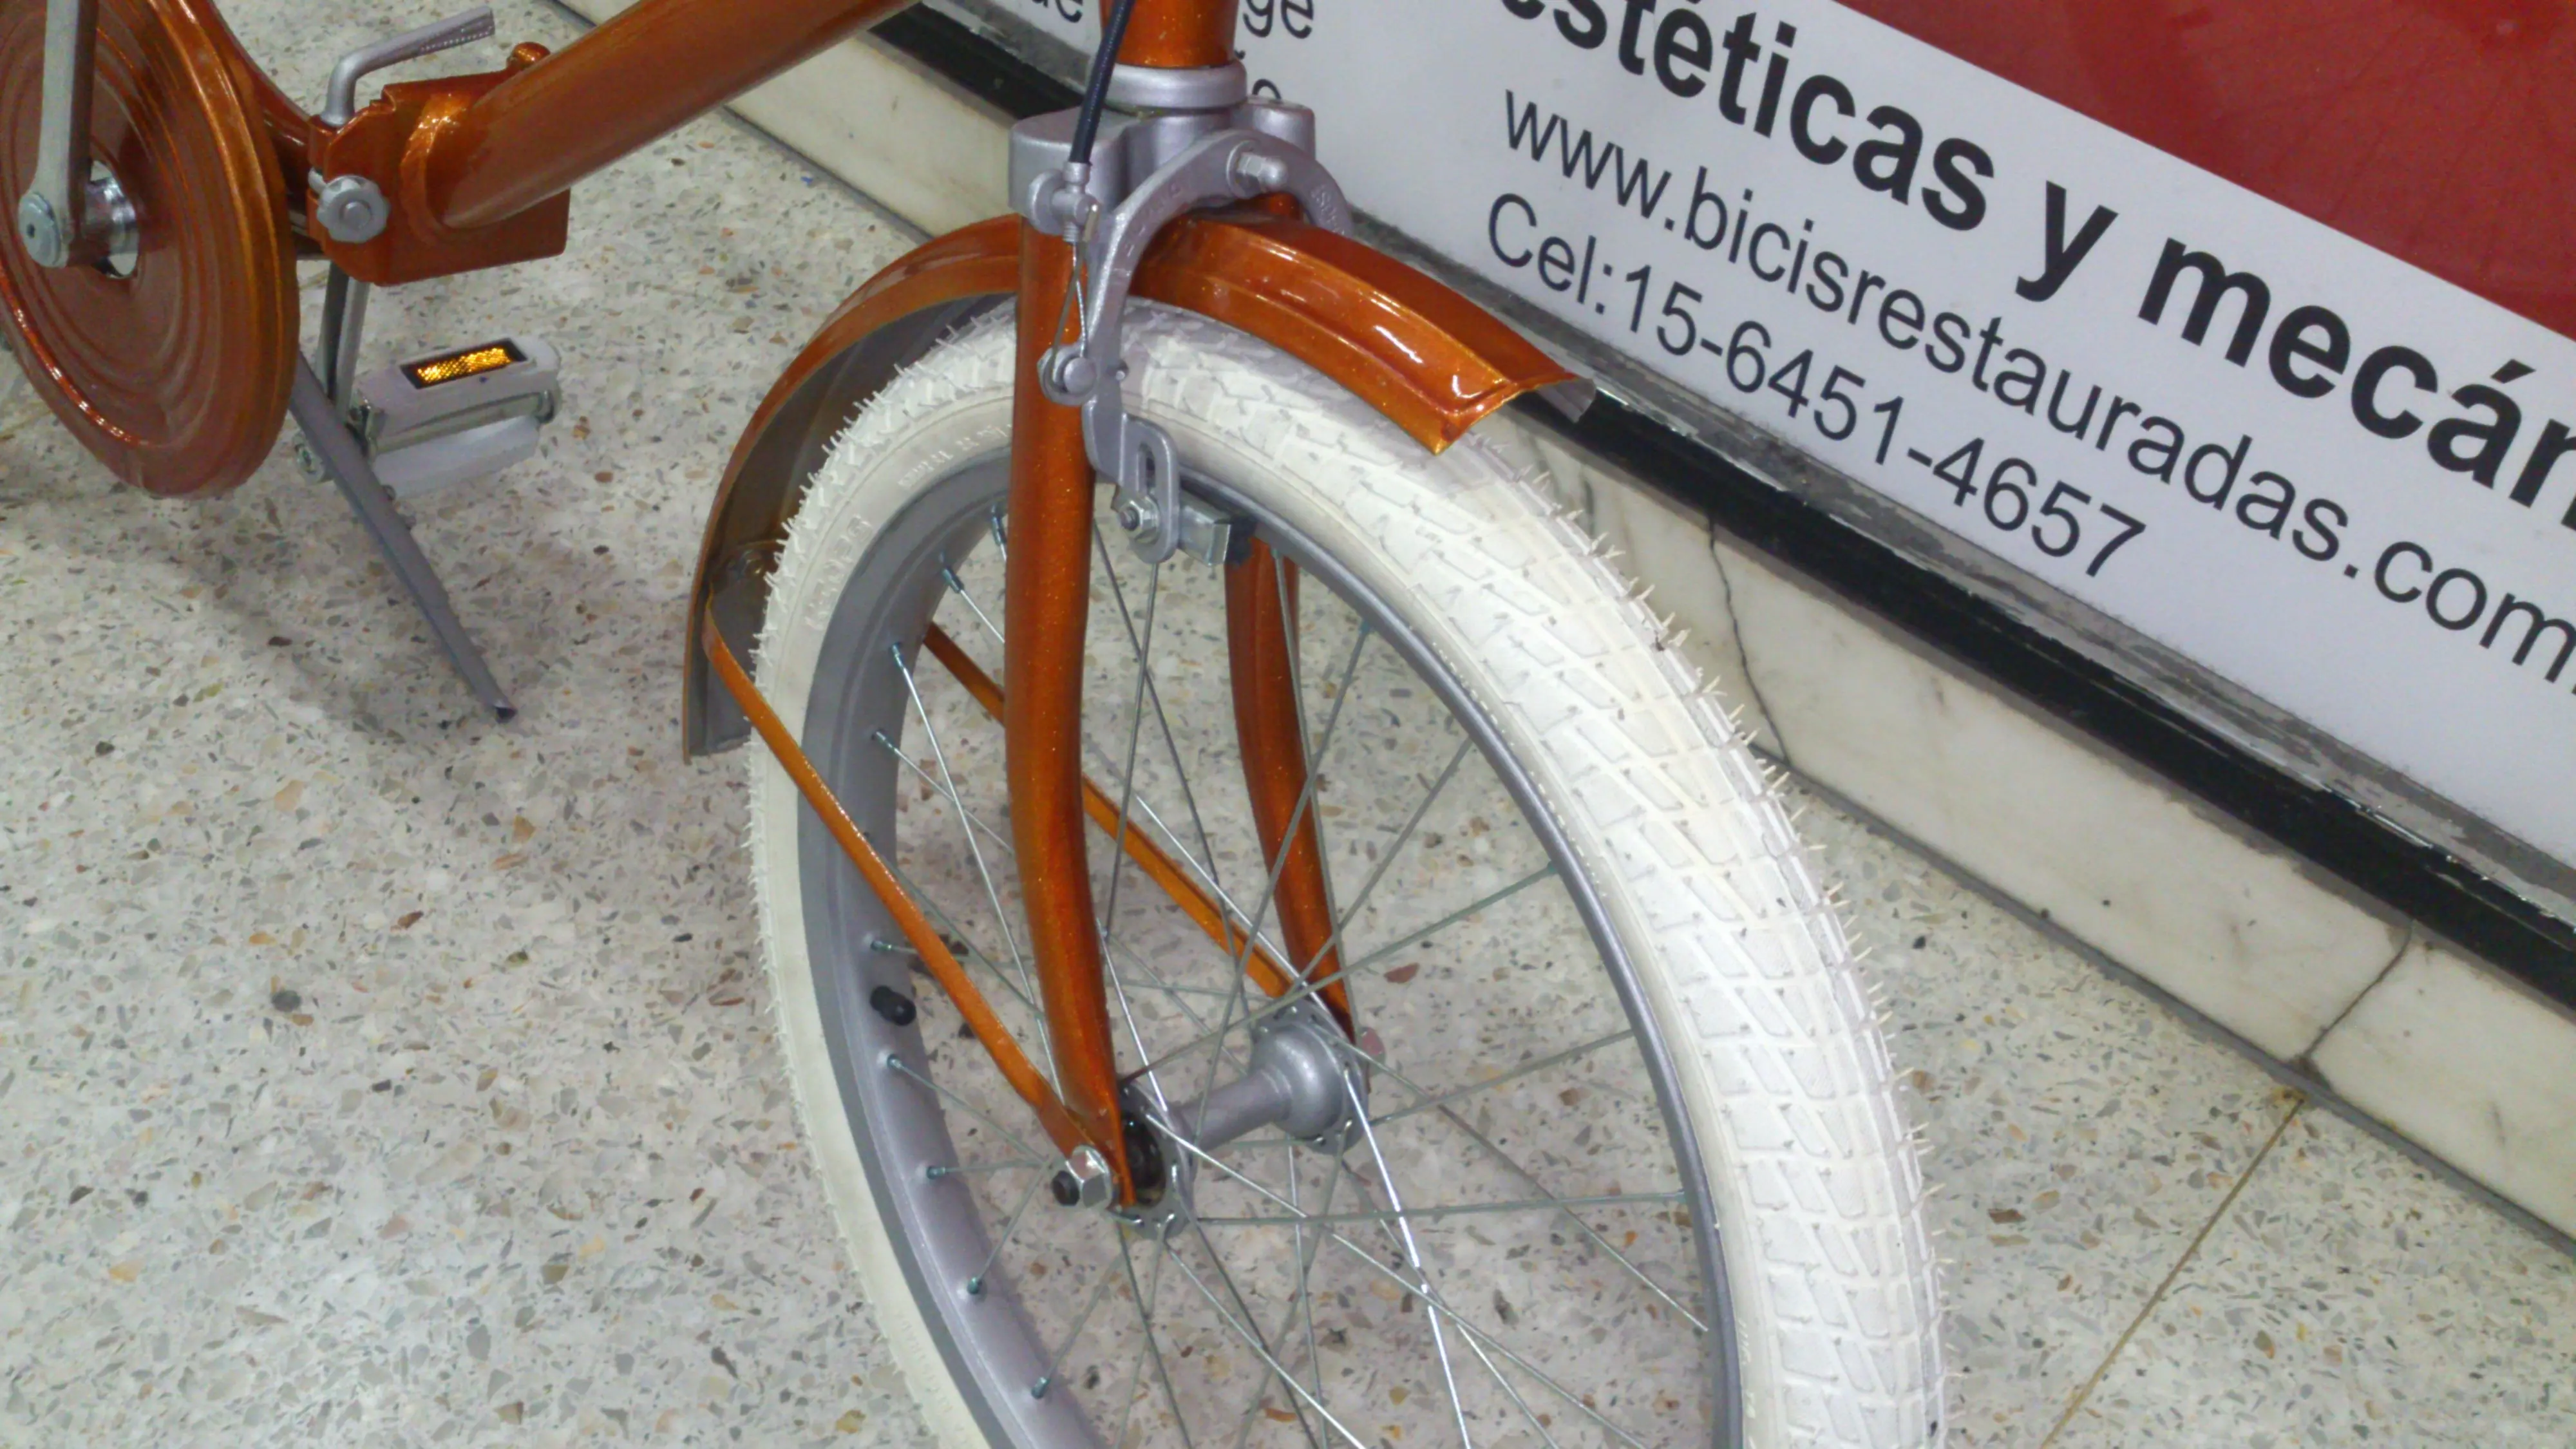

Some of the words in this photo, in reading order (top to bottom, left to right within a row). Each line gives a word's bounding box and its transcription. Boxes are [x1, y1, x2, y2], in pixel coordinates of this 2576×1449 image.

[1502, 0, 1994, 231] stéticas
[2015, 180, 2119, 303] y
[1488, 193, 2147, 577] Cel:15-6451-4657
[1505, 89, 2576, 685] www.bicisrestauradas.com
